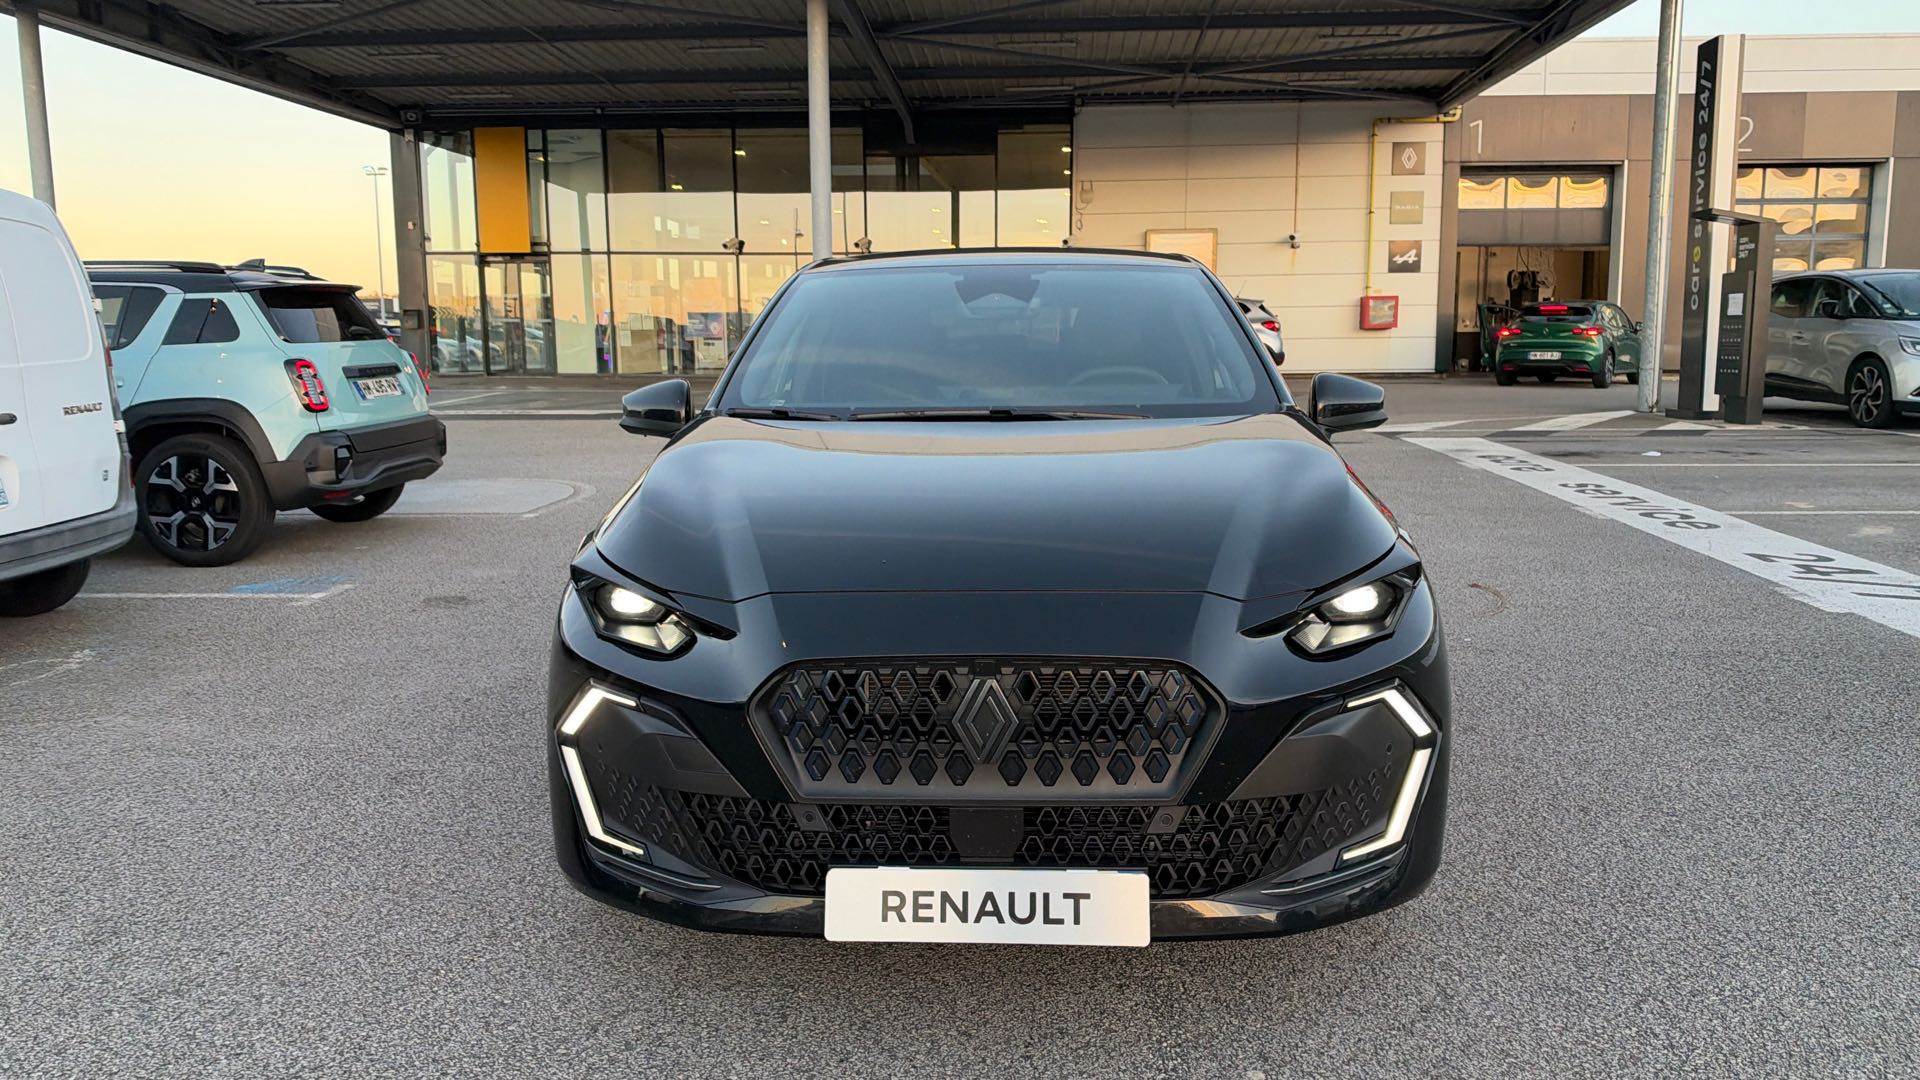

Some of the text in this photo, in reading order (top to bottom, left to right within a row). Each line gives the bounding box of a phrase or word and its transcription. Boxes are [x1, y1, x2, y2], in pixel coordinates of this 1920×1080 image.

[1699, 60, 1712, 125] 24/7
[1470, 119, 1483, 154] 1
[1738, 116, 1754, 152] 2
[62, 402, 102, 416] RENAULT
[1558, 483, 1721, 530] service
[881, 890, 1091, 925] RENAULT
